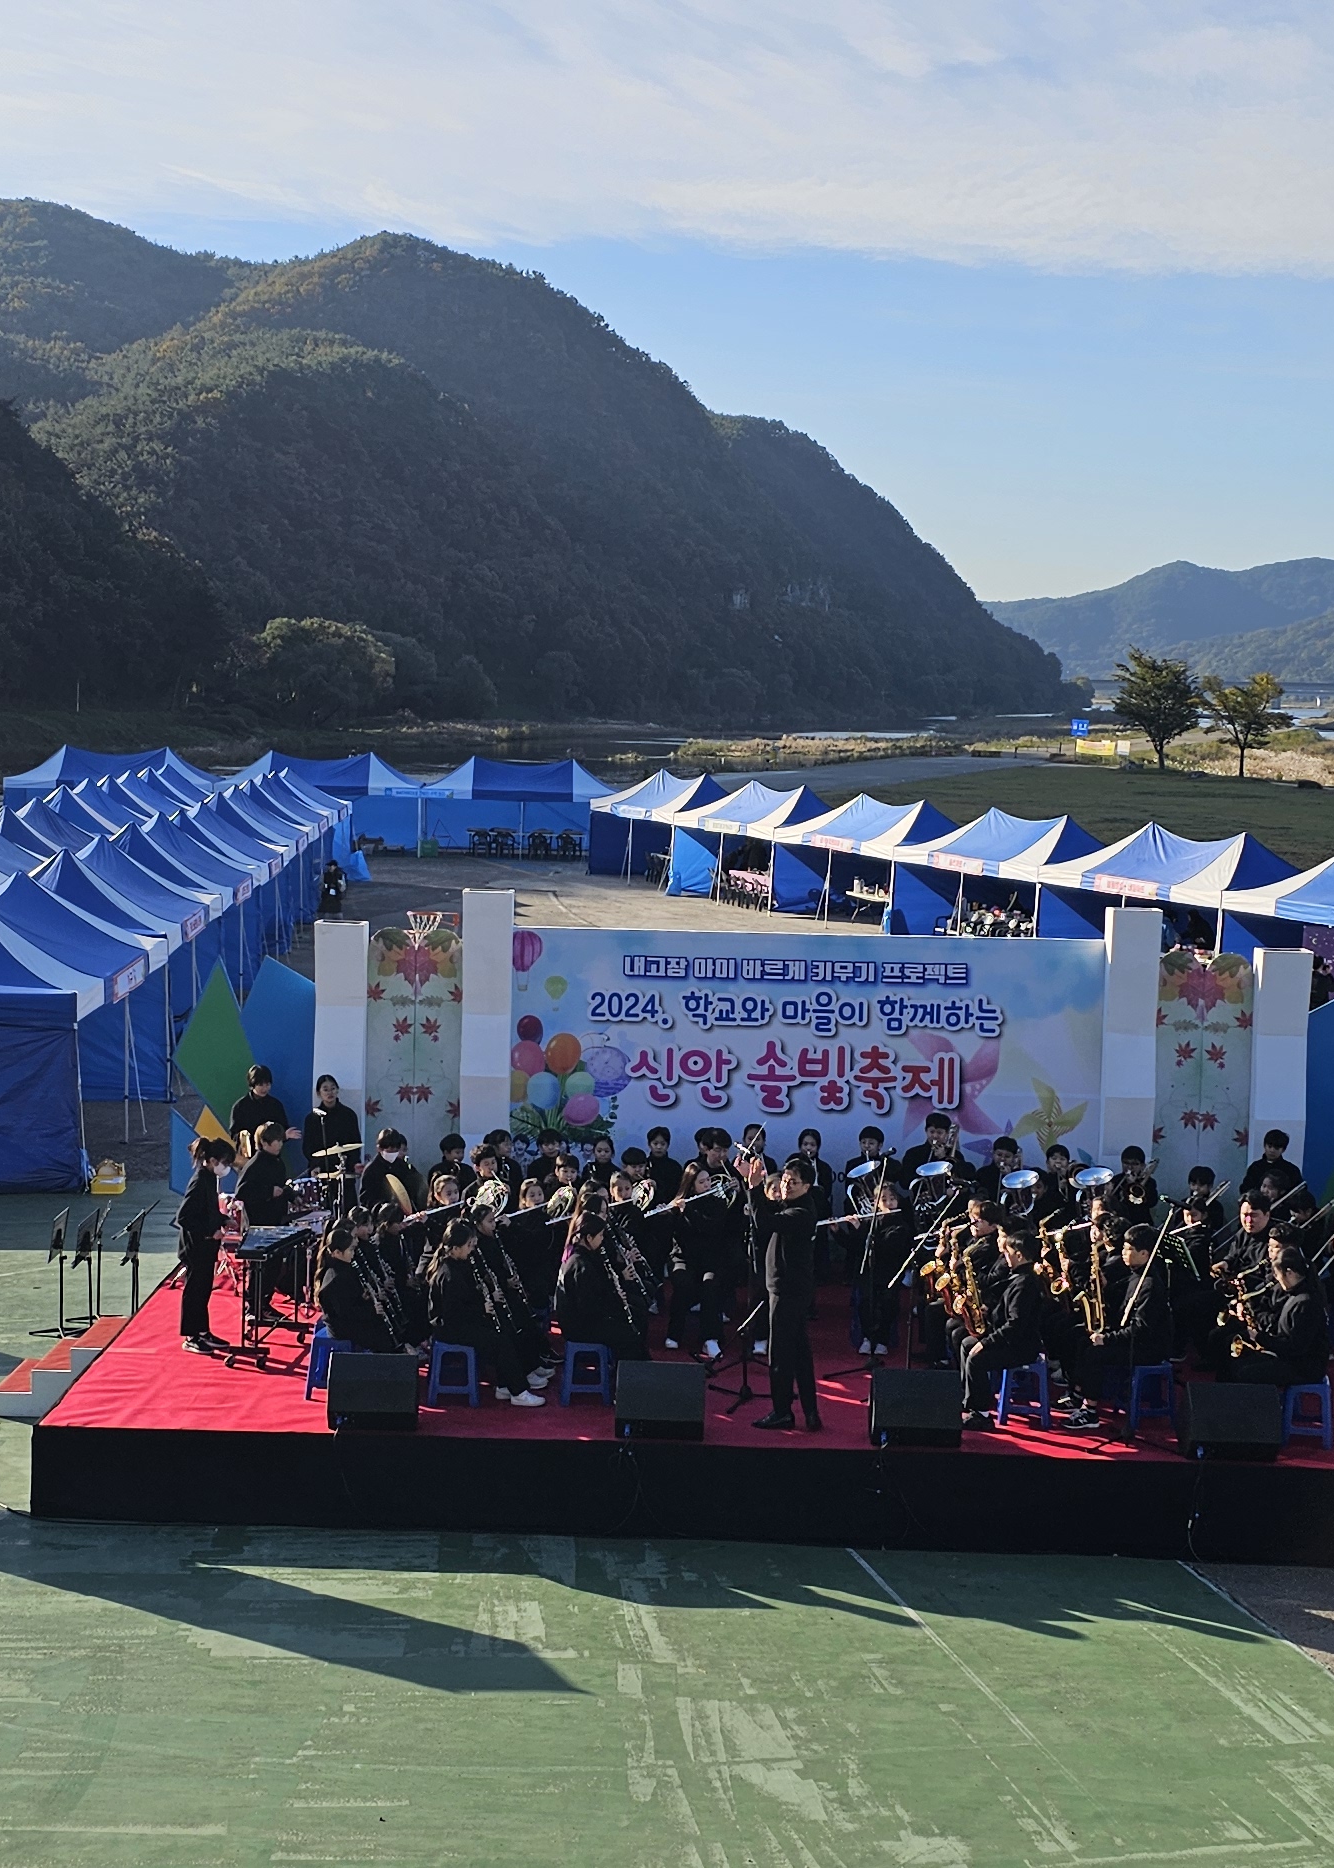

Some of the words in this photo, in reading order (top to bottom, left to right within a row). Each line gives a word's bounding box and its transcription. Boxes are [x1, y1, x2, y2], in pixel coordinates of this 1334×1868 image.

[624, 956, 687, 978] 내고장
[693, 958, 735, 979] 아이
[742, 959, 805, 981] 바르게
[811, 961, 876, 983] 키우기
[882, 963, 968, 985] 프로젝트
[590, 991, 670, 1027] 2024.
[683, 991, 769, 1026] 학교와
[781, 991, 865, 1033] 마을이
[878, 996, 1002, 1034] 함께하는
[630, 1043, 733, 1105] 신안
[747, 1040, 960, 1111] 솔빛축제
